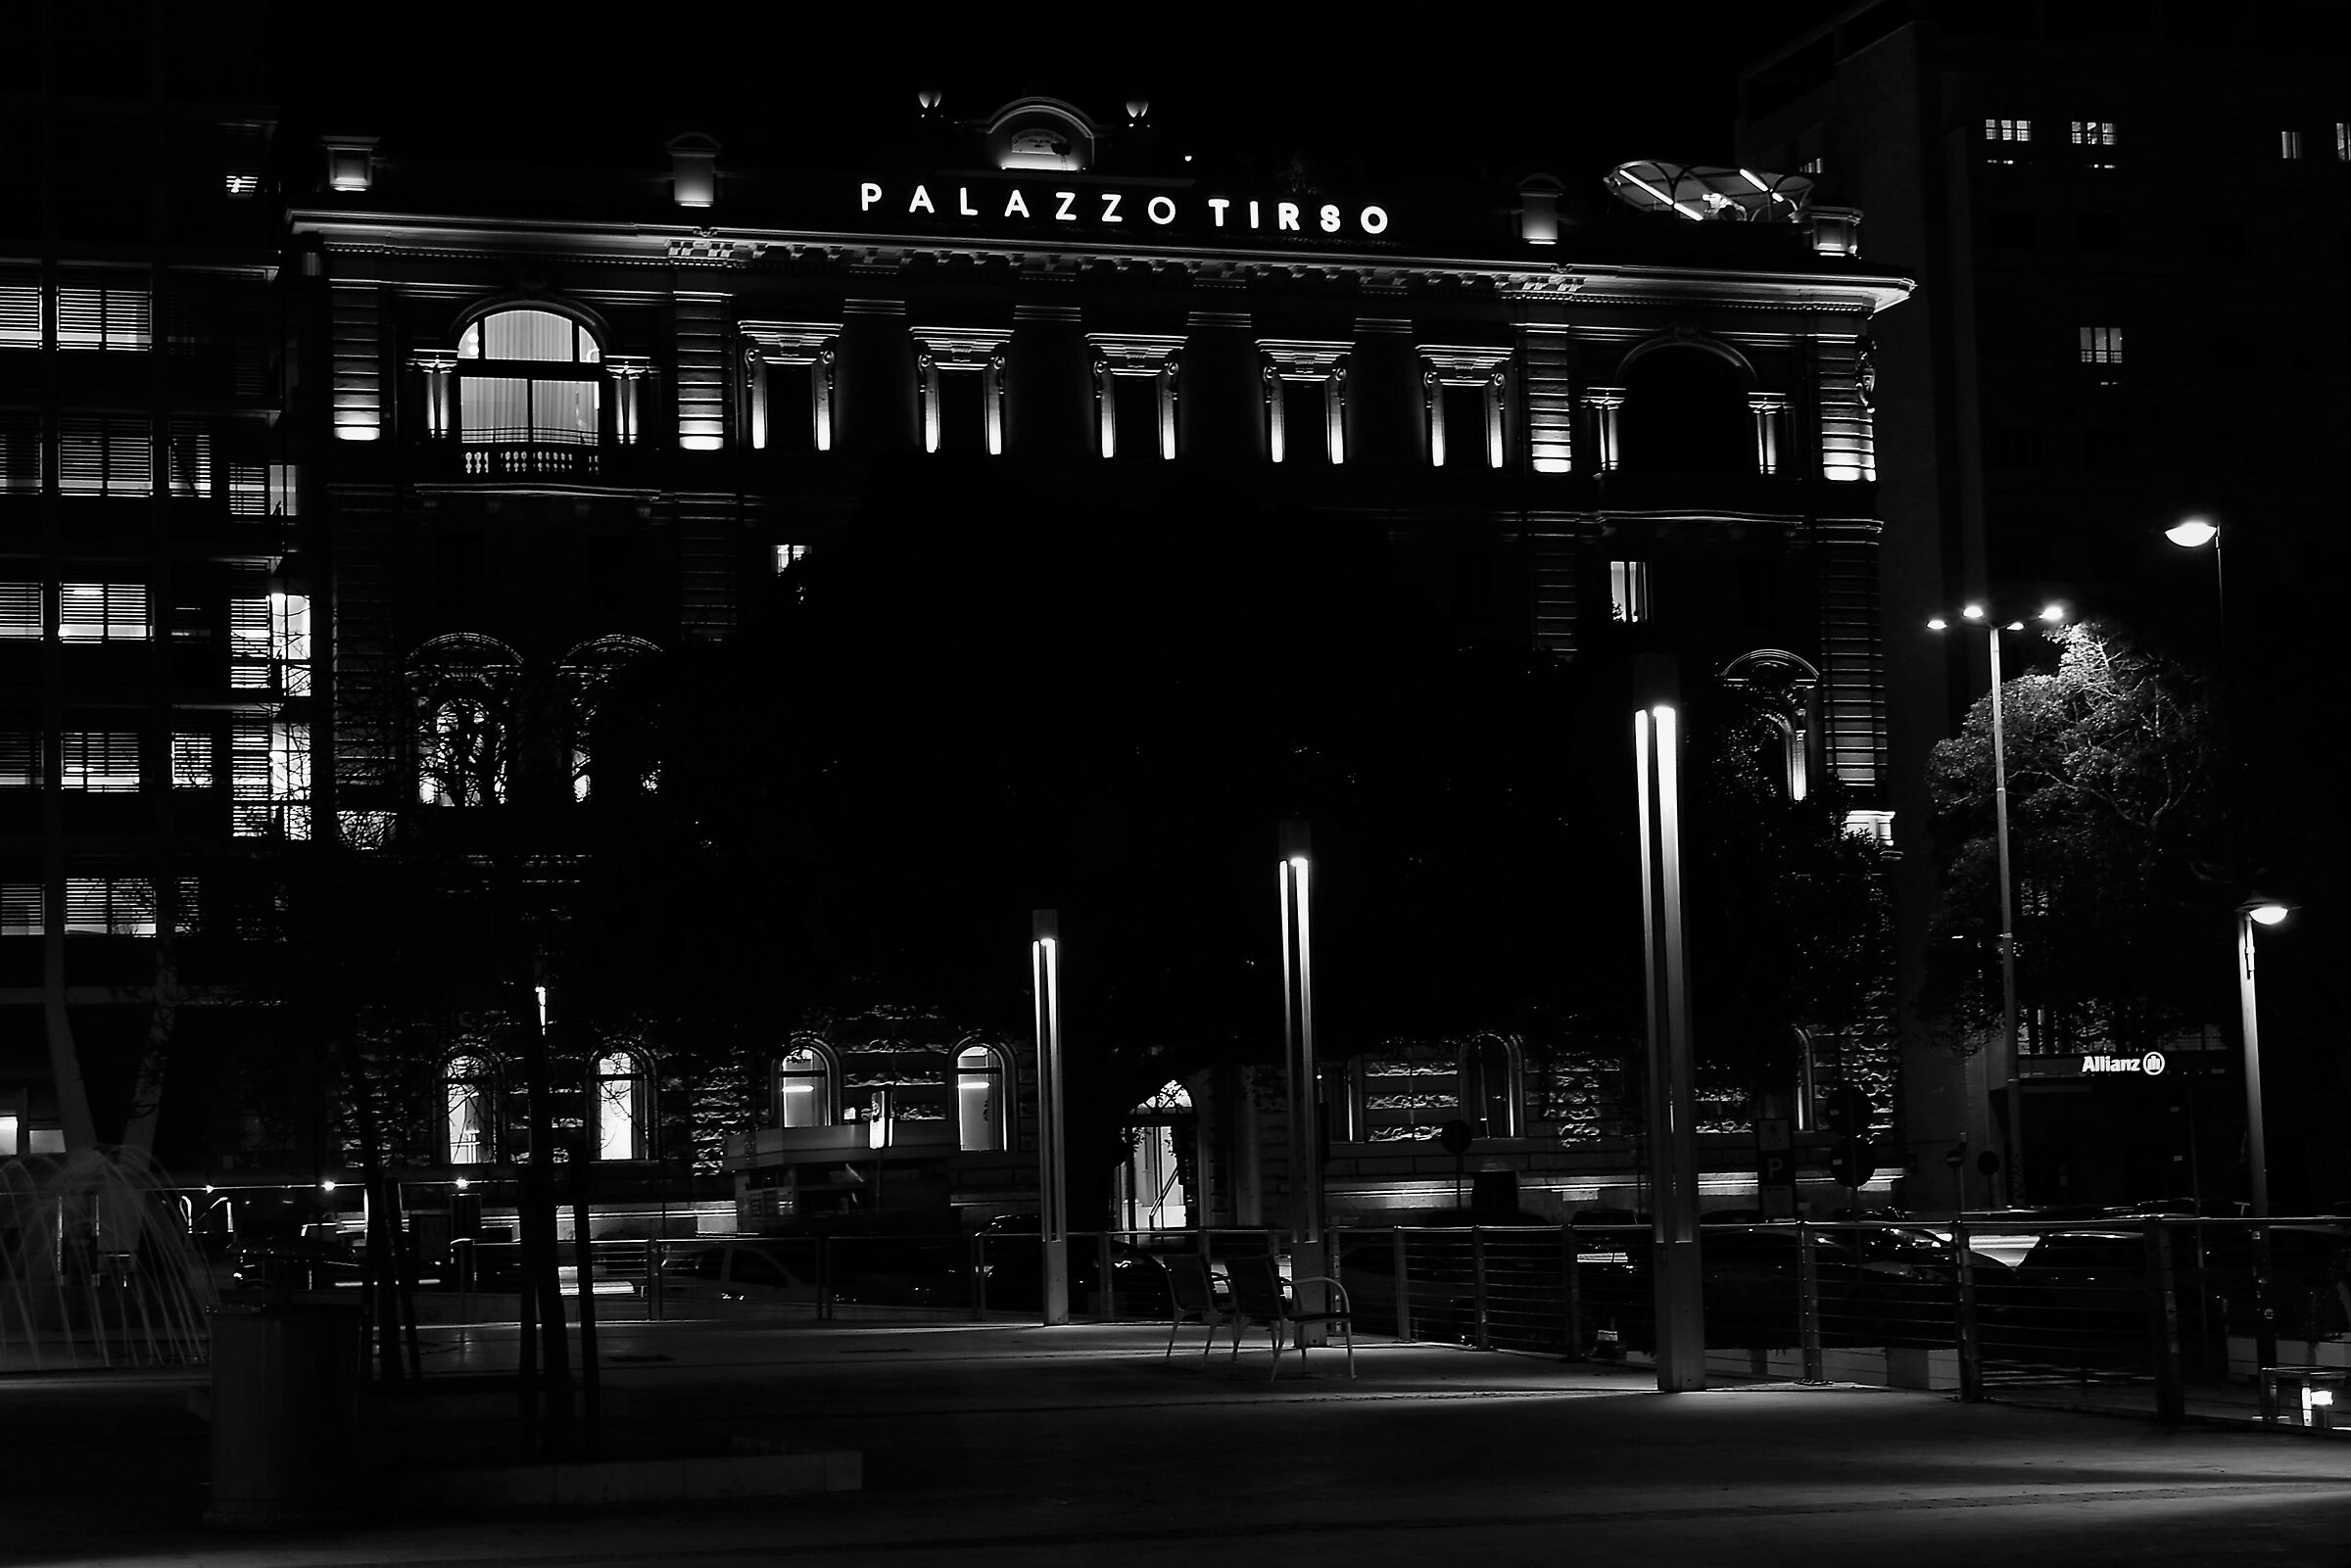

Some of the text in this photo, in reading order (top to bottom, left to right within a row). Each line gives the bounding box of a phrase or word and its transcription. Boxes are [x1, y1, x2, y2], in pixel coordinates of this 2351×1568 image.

[860, 182, 1388, 234] PALAZZO TIRSO
[2081, 1055, 2141, 1072] Allianz
[1767, 1158, 1784, 1178] P
